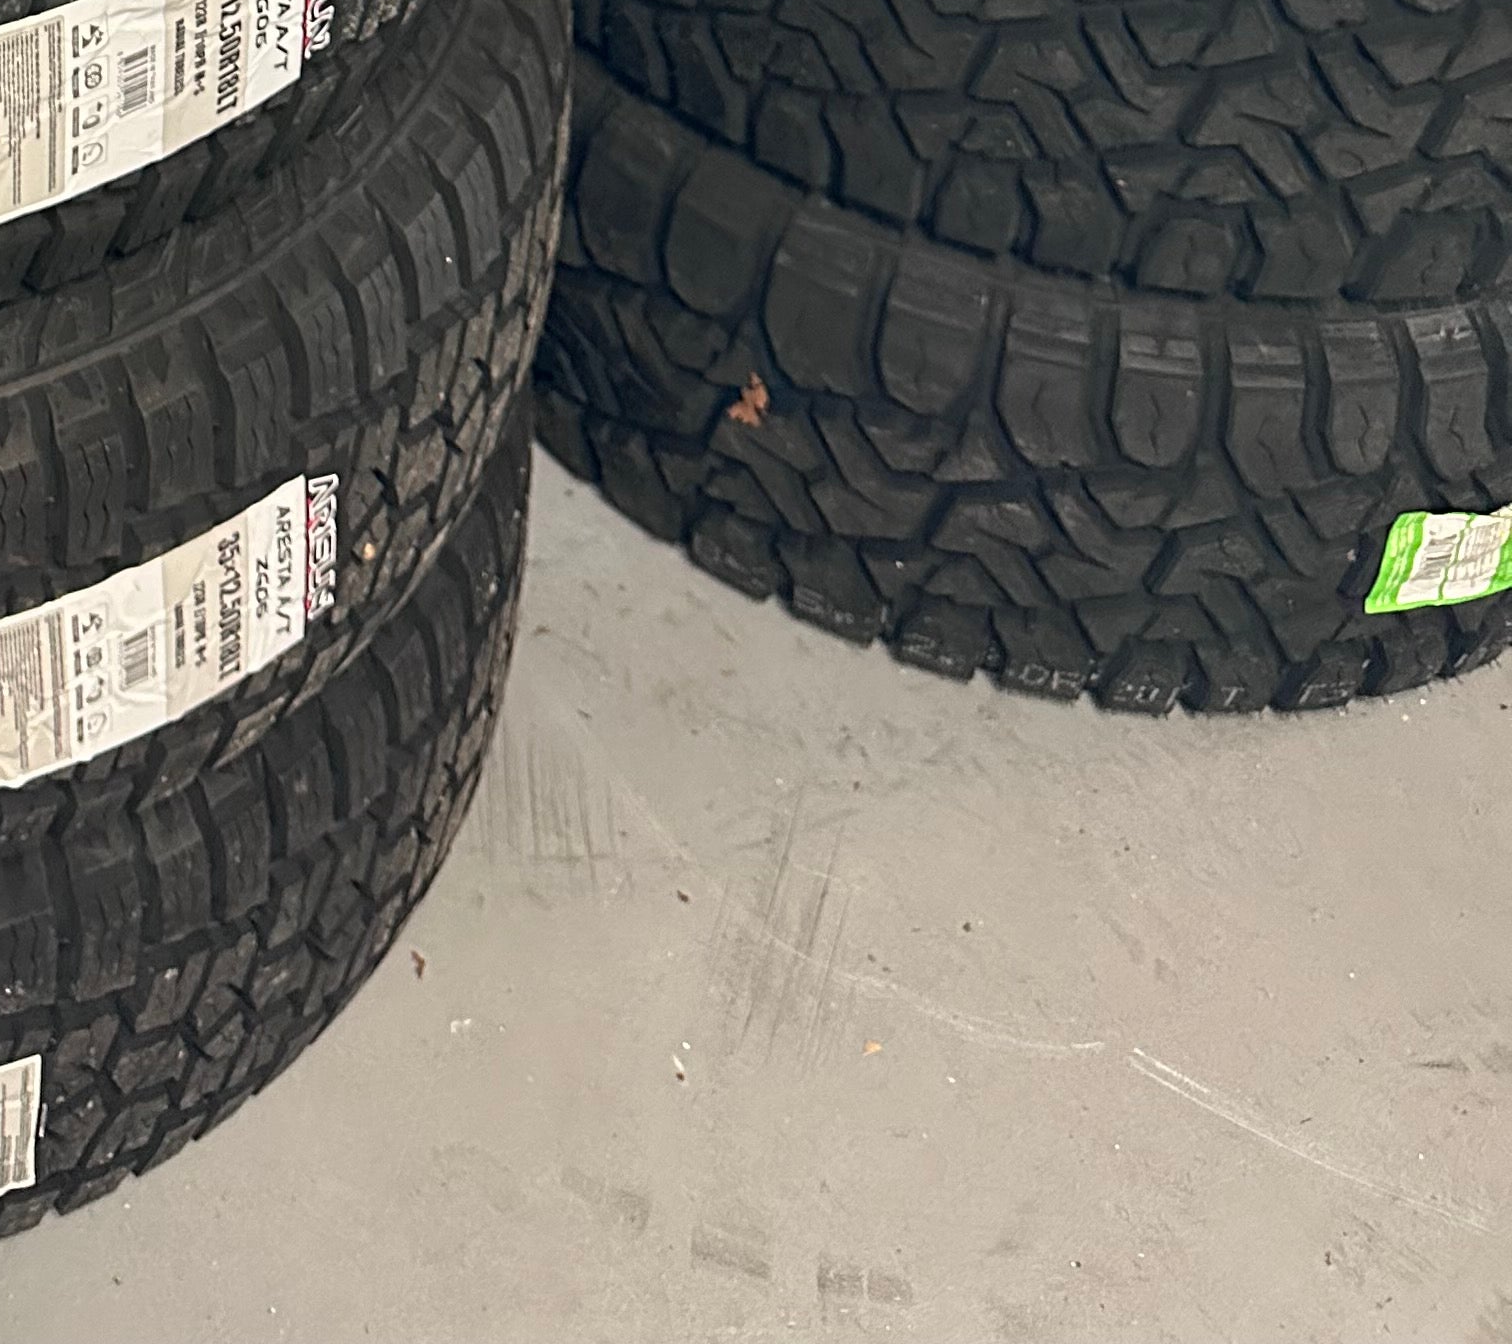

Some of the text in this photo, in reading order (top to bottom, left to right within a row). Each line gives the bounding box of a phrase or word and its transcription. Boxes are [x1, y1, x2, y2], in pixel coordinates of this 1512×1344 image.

[274, 24, 290, 71] A/T
[275, 506, 292, 635] ARESTA A/T
